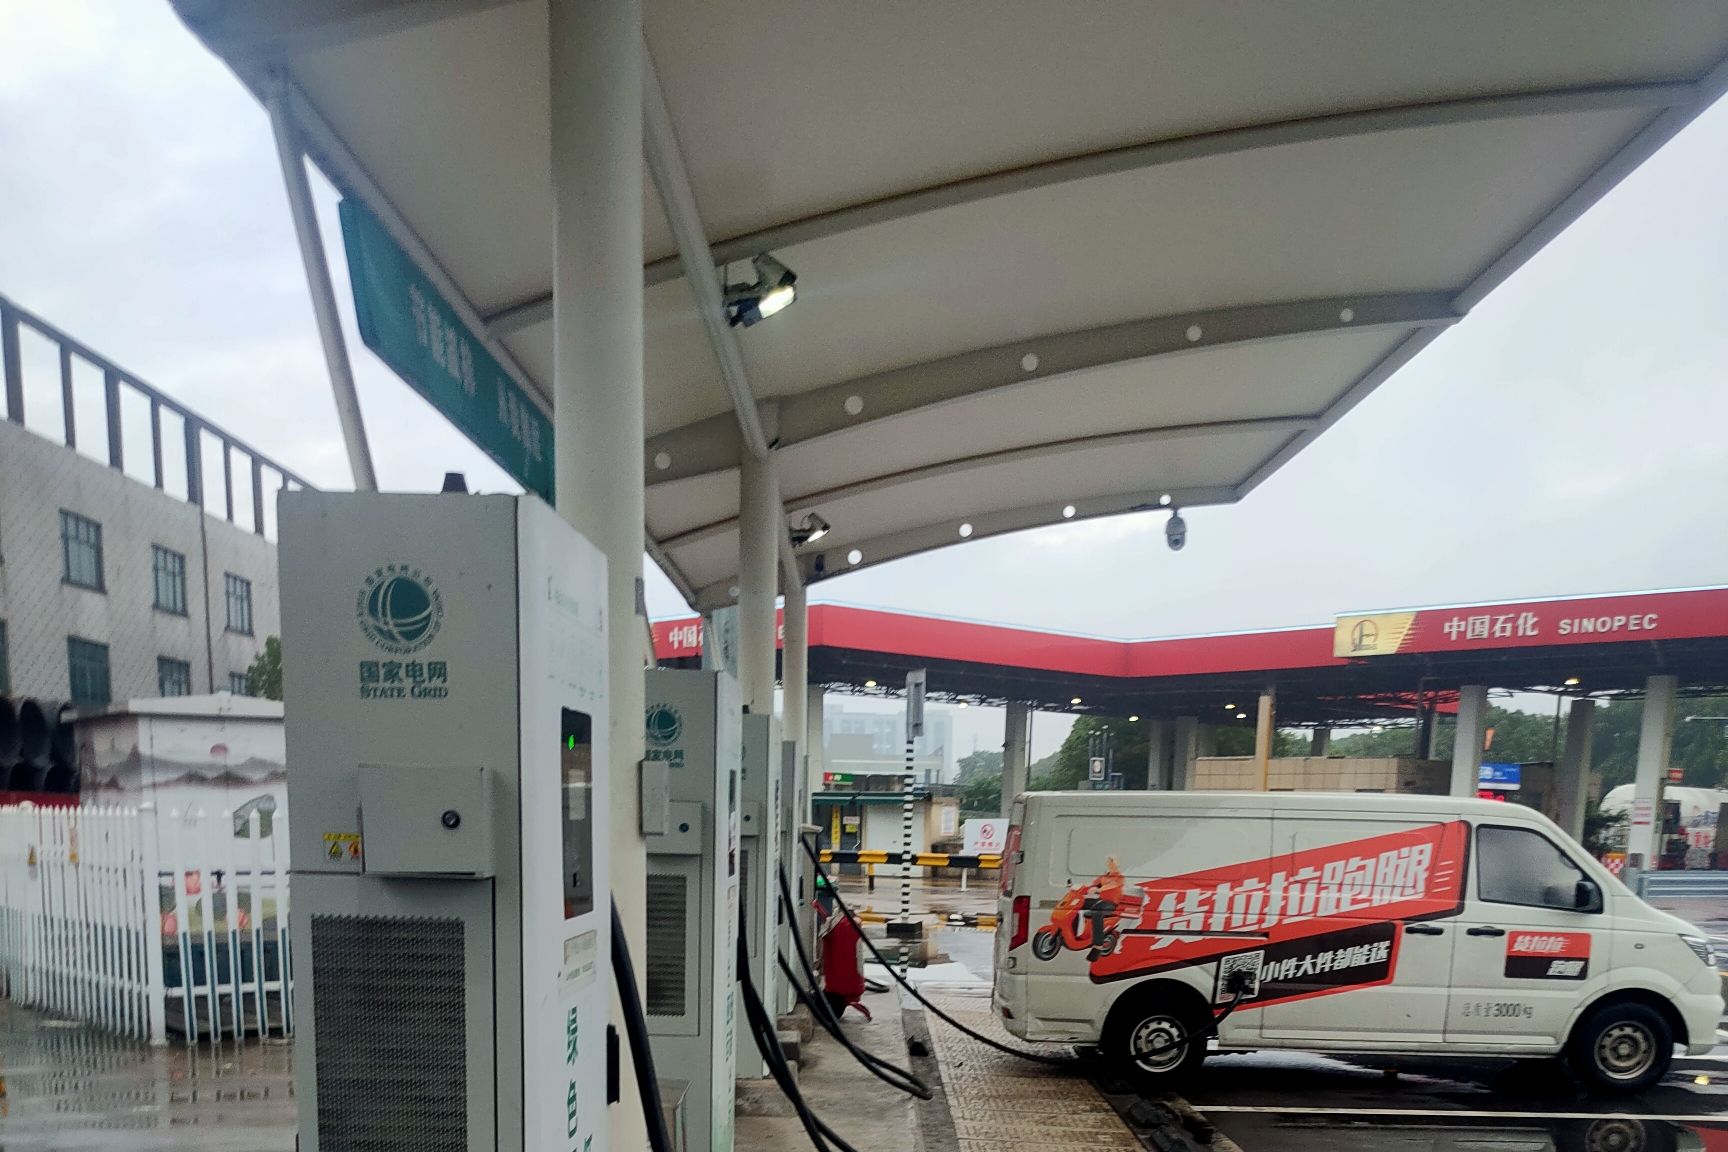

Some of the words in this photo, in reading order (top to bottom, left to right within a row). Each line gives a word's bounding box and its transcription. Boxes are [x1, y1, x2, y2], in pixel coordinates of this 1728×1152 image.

[669, 625, 703, 650] 中国
[1443, 612, 1539, 641] 中国石化
[1558, 613, 1658, 635] SINOPEC
[359, 660, 448, 685] 国家电网
[1150, 843, 1433, 950] 货拉拉跑腿
[1260, 940, 1391, 983] 小件大件都能送
